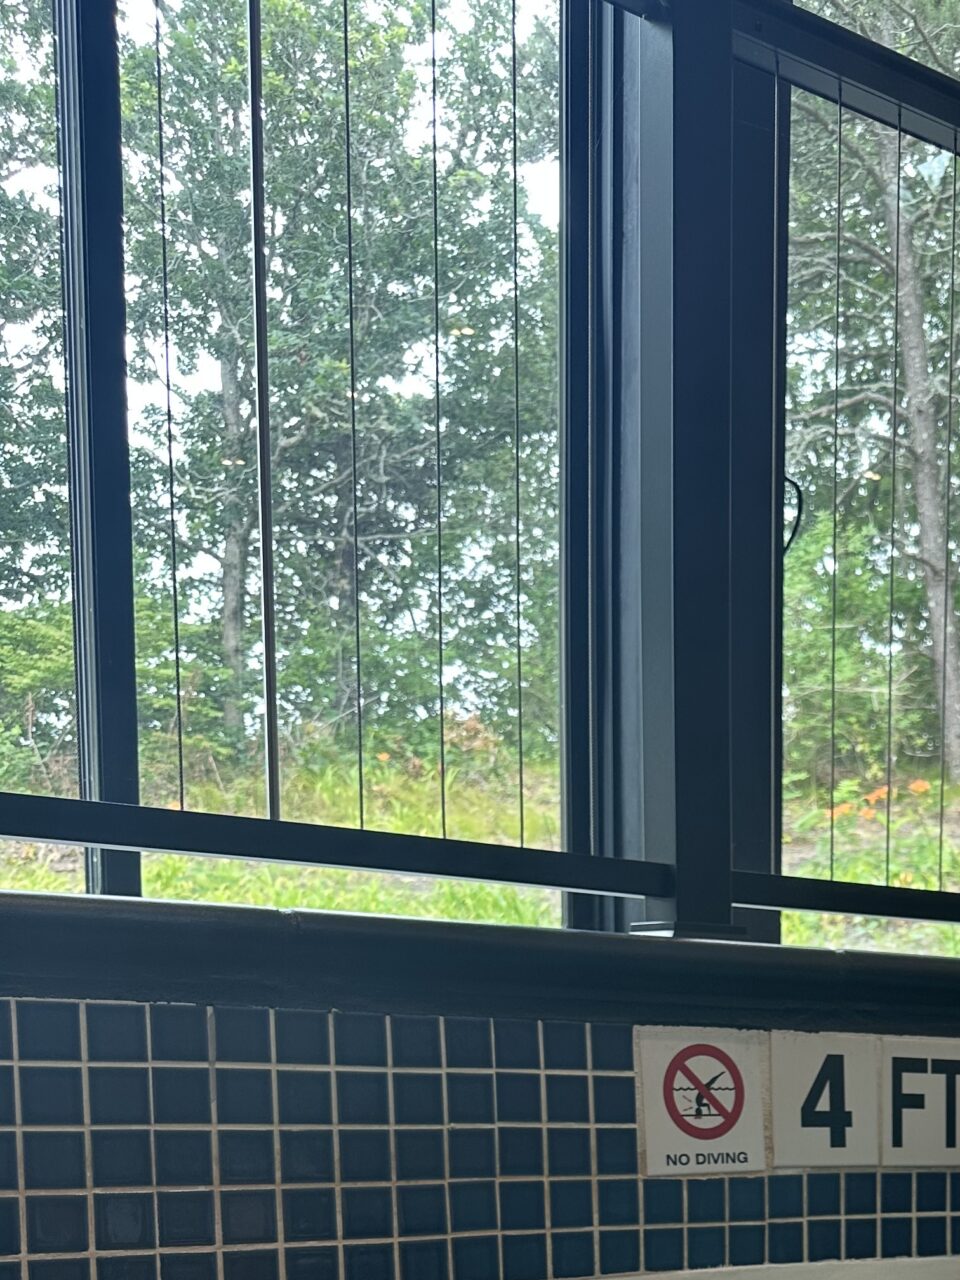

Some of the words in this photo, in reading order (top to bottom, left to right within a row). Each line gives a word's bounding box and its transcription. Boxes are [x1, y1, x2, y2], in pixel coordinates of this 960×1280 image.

[801, 1054, 853, 1148] 4
[666, 1153, 691, 1166] NO
[695, 1151, 749, 1166] DIVING
